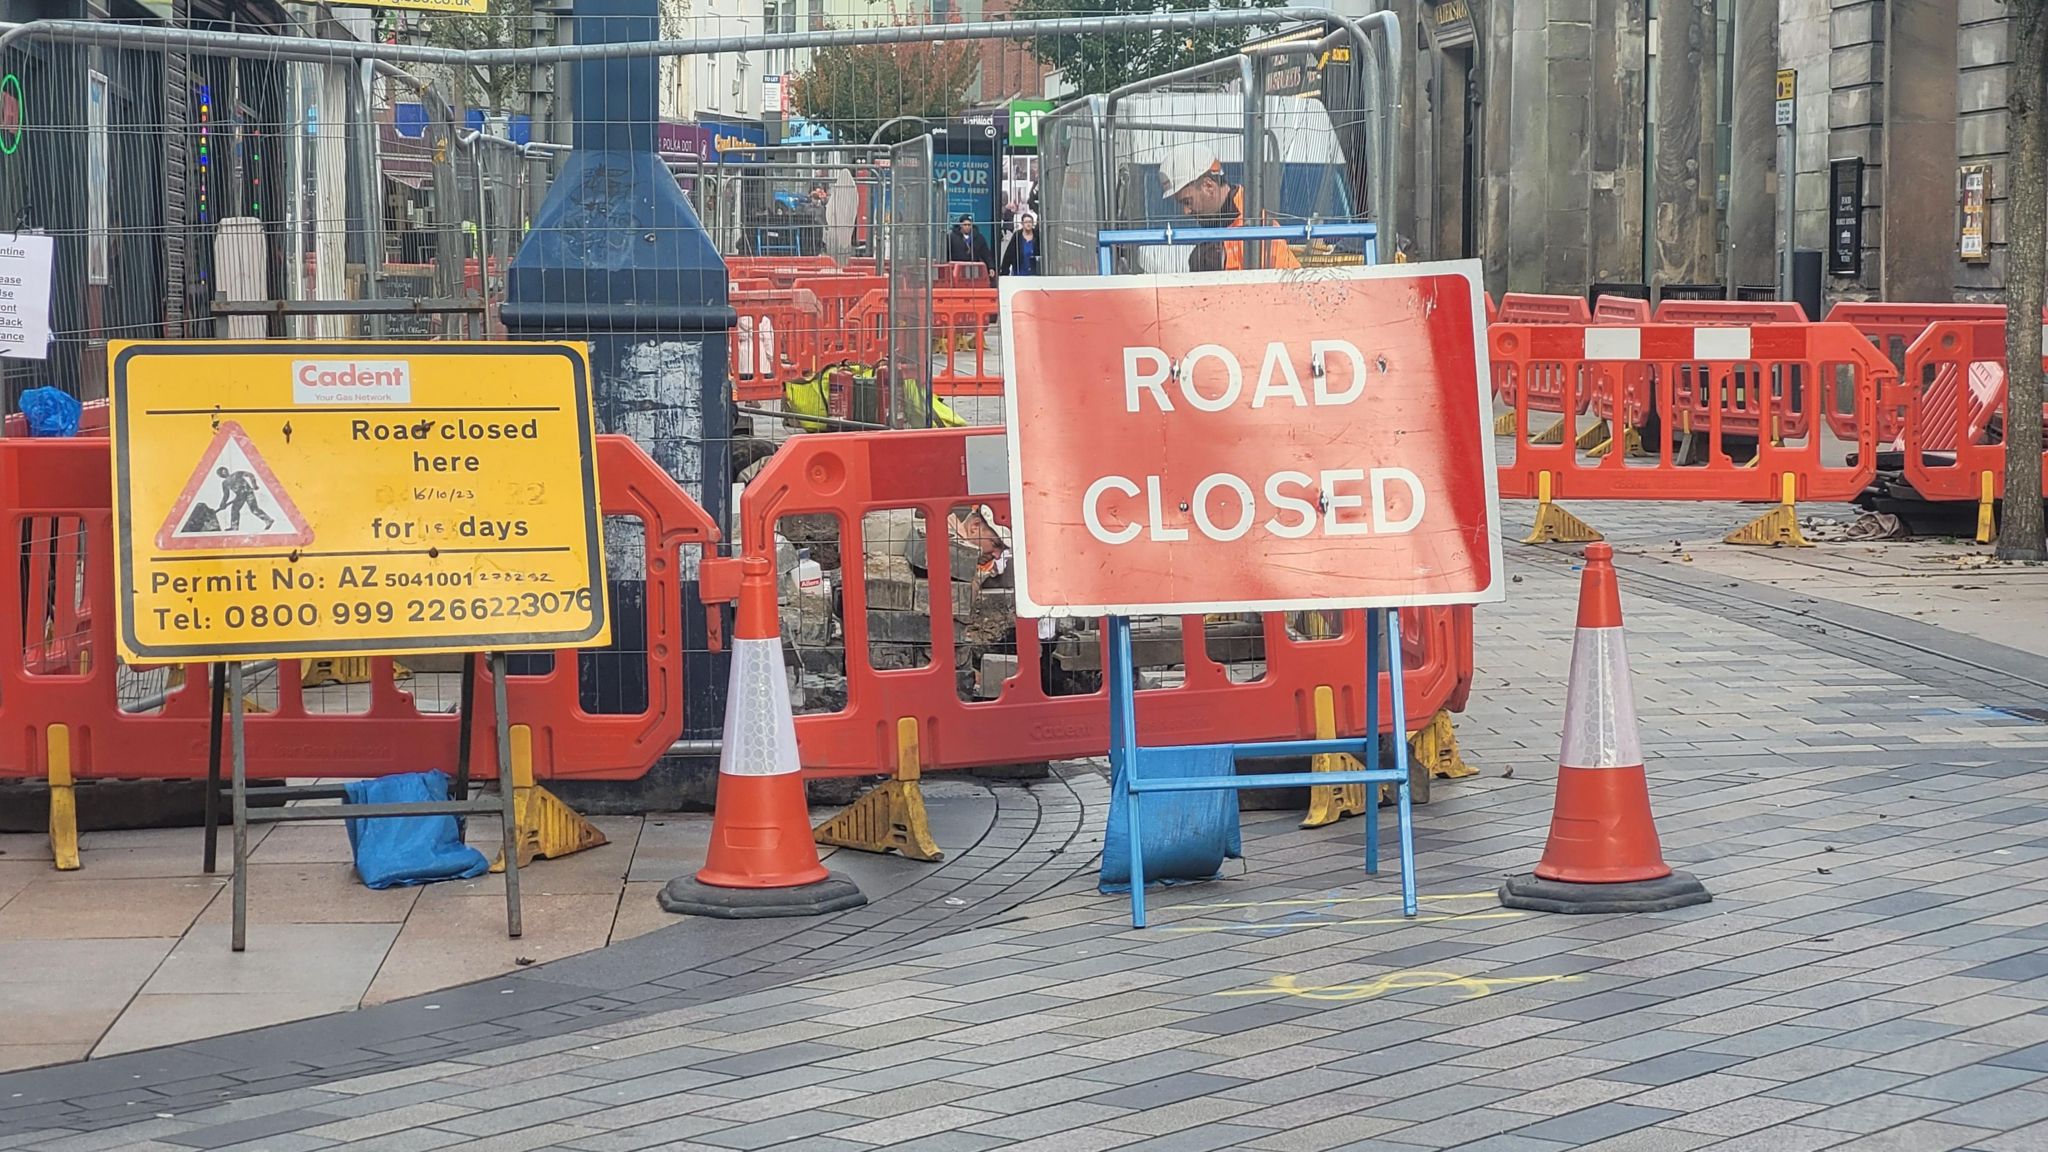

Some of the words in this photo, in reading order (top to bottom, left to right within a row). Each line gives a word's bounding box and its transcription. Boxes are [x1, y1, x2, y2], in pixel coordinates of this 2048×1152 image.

[663, 138, 681, 151] POLKA
[681, 139, 692, 152] DOT
[935, 169, 988, 185] YOUR
[298, 363, 404, 387] Cadent
[1123, 339, 1367, 413] ROAD
[355, 393, 392, 401] Network
[351, 419, 428, 441] Road
[440, 419, 538, 440] closed
[413, 451, 480, 472] here
[414, 486, 475, 503] 16/10/23
[1082, 467, 1426, 545] CLOSED
[371, 517, 415, 539] for
[459, 516, 529, 541] days
[151, 569, 257, 594] Permit
[272, 567, 325, 590] No:
[338, 565, 379, 588] AZ
[385, 572, 473, 587] 5041001
[153, 607, 211, 630] Tel:
[224, 603, 318, 629] 0800
[332, 600, 394, 625] 999
